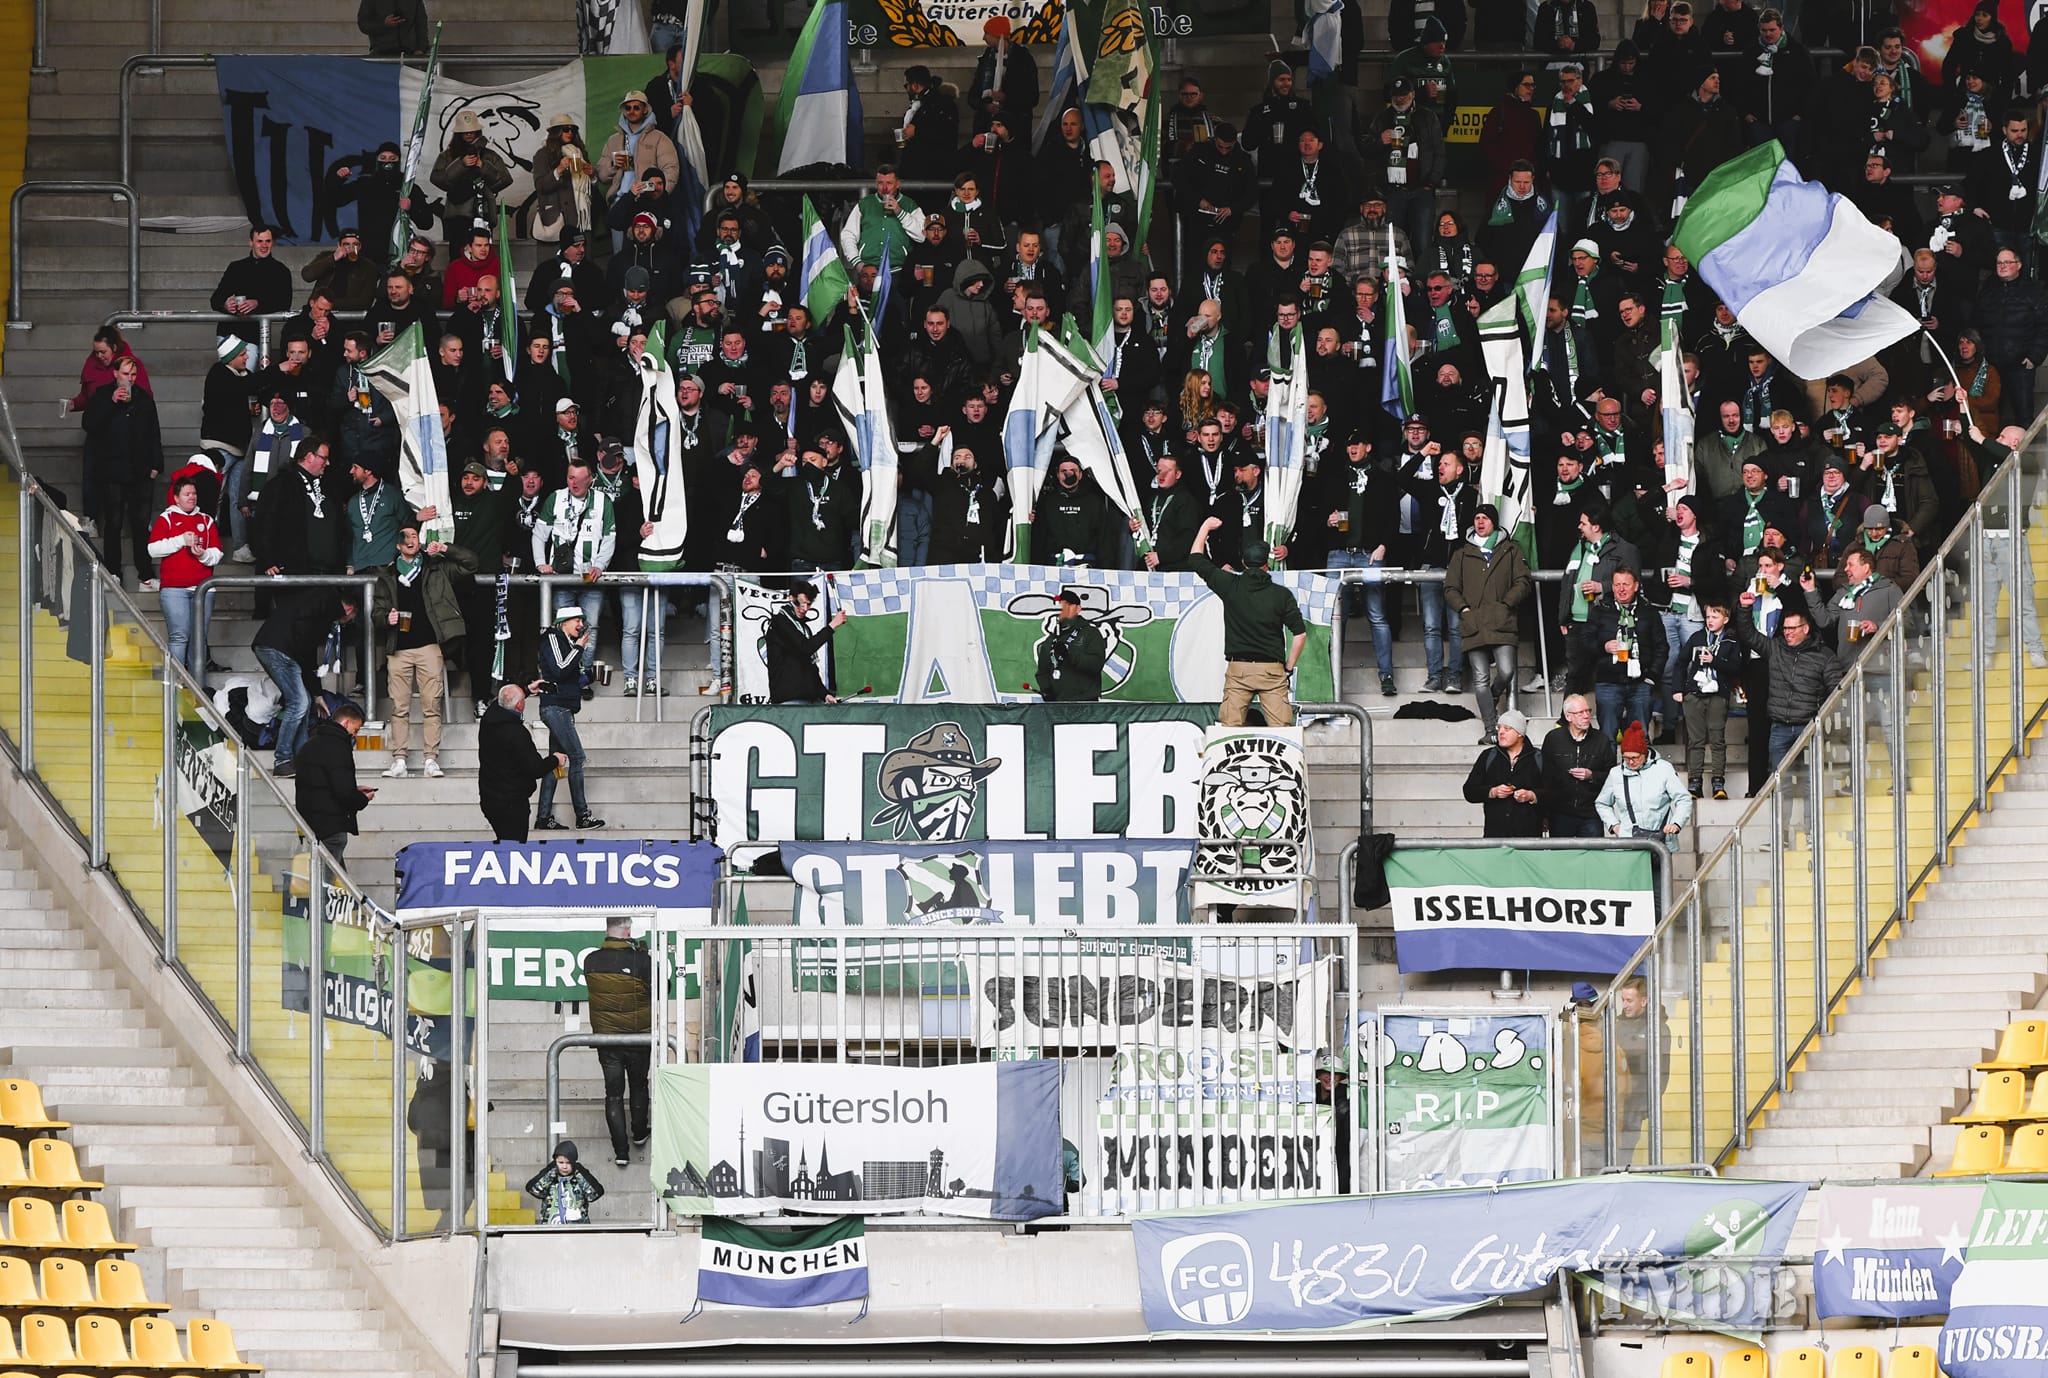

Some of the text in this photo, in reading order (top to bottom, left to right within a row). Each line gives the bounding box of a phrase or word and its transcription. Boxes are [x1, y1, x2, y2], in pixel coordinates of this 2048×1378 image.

[927, 2, 1034, 20] Gütersloh
[1224, 739, 1287, 758] AKTIVE
[444, 850, 680, 889] FANATICS
[1413, 895, 1632, 927] ISSELHORST
[984, 974, 1300, 1037] SUNDERN
[763, 1089, 948, 1124] Gütersloh
[1414, 1090, 1499, 1122] R.I.P
[1103, 1134, 1321, 1191] MINDEN
[713, 1241, 860, 1276] MÜNCHEN
[1268, 1239, 1428, 1308] 4830
[1178, 1262, 1243, 1291] FCG
[1852, 1256, 1938, 1303] Münden
